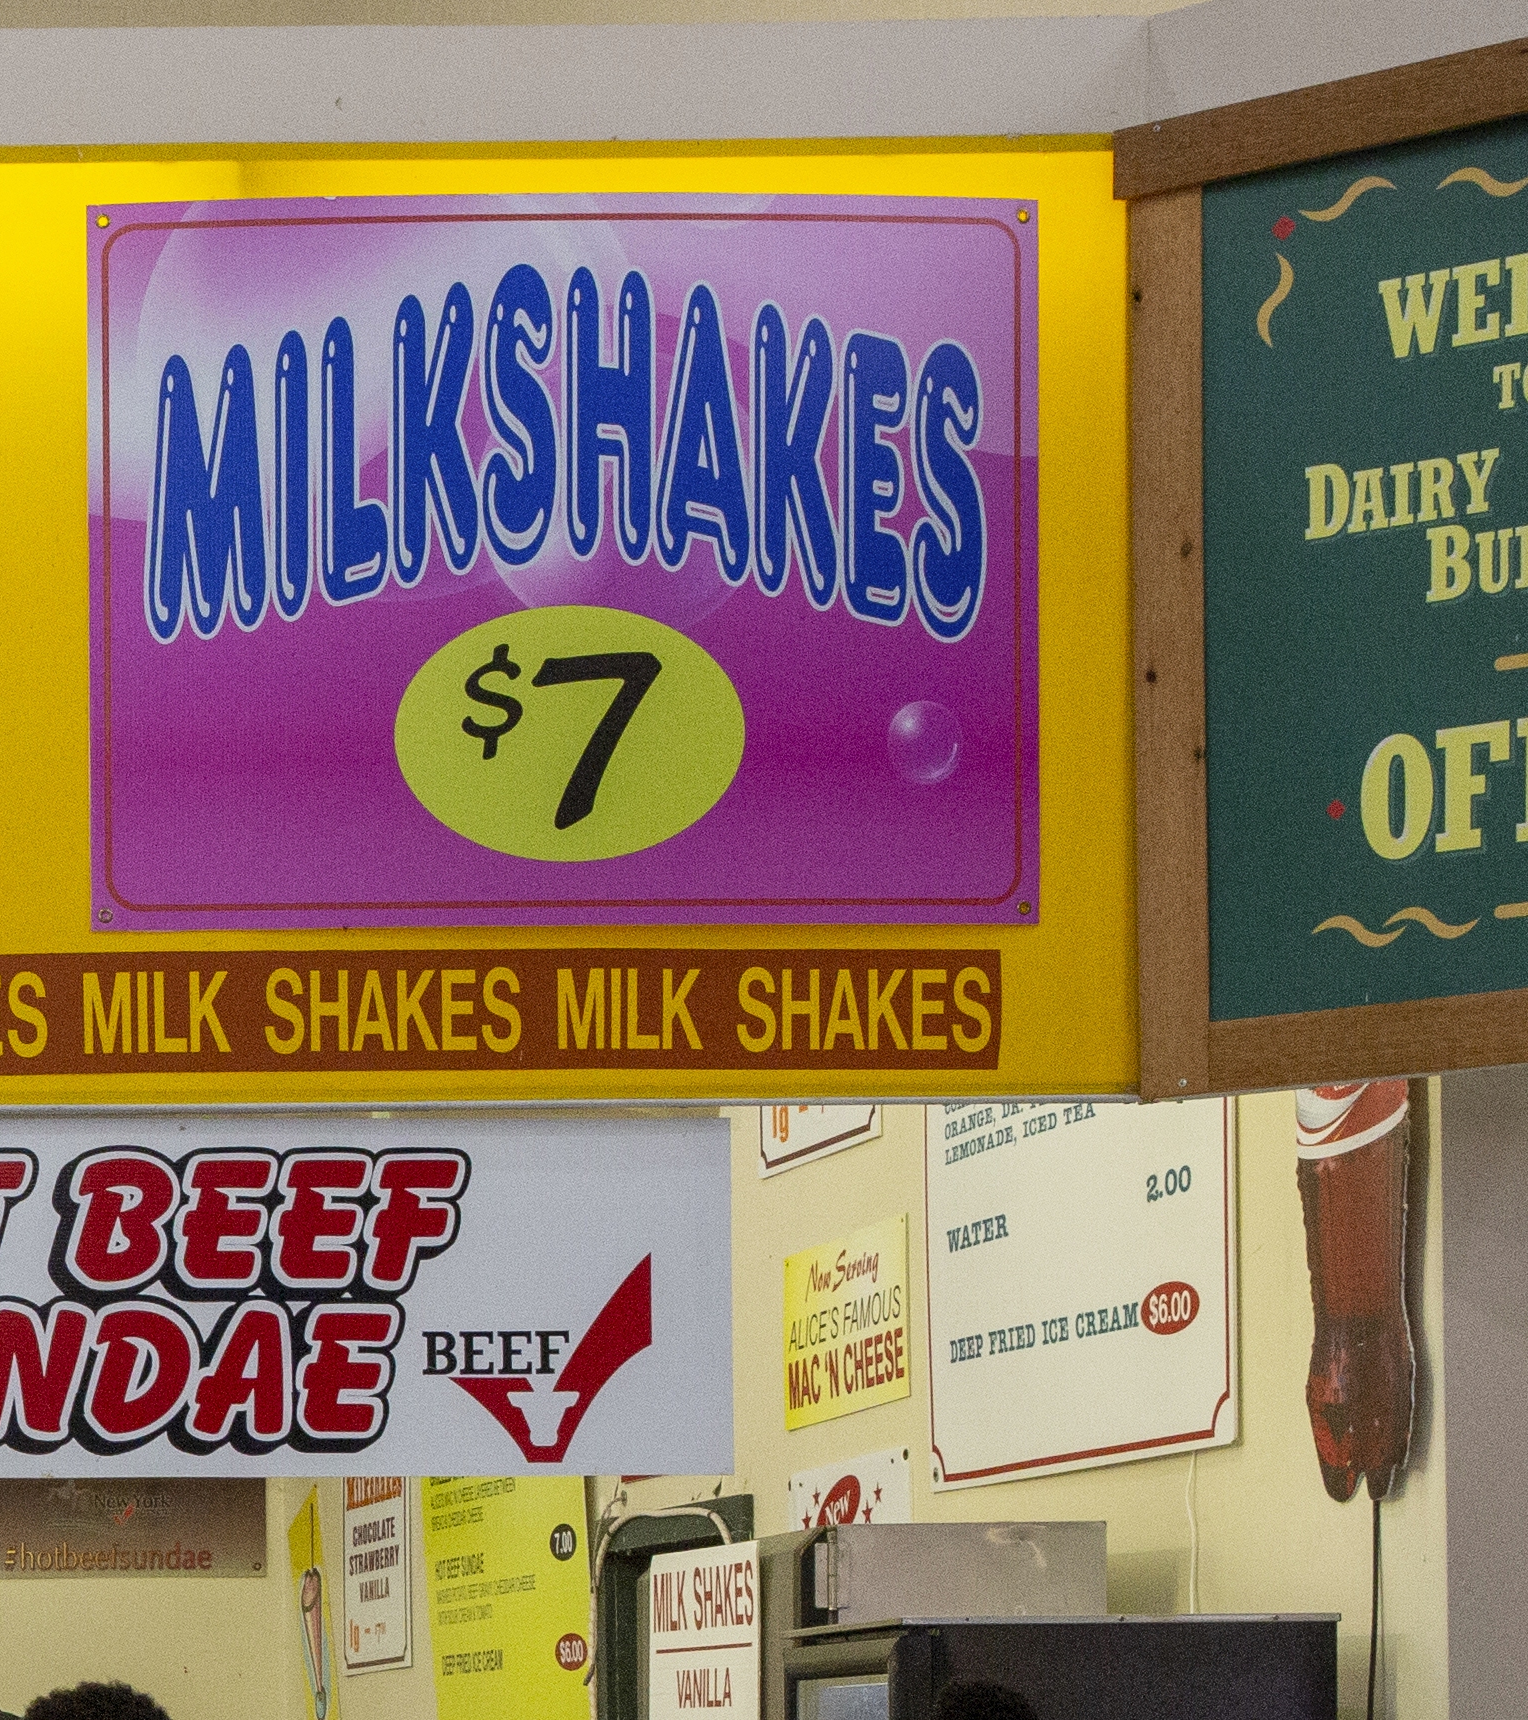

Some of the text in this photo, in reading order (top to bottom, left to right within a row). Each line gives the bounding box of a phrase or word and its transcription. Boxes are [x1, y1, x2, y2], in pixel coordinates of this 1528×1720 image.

[143, 263, 988, 644] MILKSHAKES
[1305, 448, 1499, 540] DAIRY
[462, 644, 663, 830] $7
[81, 971, 232, 1058] MILK
[264, 967, 522, 1055] SHAKES
[556, 967, 704, 1052] MILK
[736, 966, 993, 1053] SHAKES
[944, 1107, 996, 1140] ORANGE,
[944, 1103, 1096, 1165] LEMONADE, ICED TEA
[1146, 1165, 1191, 1202] 2.00
[49, 1145, 471, 1299] BEEF
[947, 1213, 1009, 1253] WATER
[805, 1249, 879, 1303] Now Serving
[789, 1284, 901, 1353] ALICE'S FAMOUS
[950, 1290, 1191, 1363] DEEP FRIED ICE CREAM $6.00
[423, 1331, 569, 1375] BEEF
[788, 1354, 821, 1410] MAC
[843, 1327, 905, 1394] CHEESE
[94, 1494, 170, 1508] New York
[5, 1542, 212, 1571] #hotbeefsundae
[352, 1517, 395, 1547] CHOCOLATE
[349, 1545, 400, 1576] STRAWBERRY
[359, 1577, 390, 1603] VANILLA
[653, 1559, 754, 1633] MILK SHAKES
[676, 1667, 732, 1708] VANILLA
